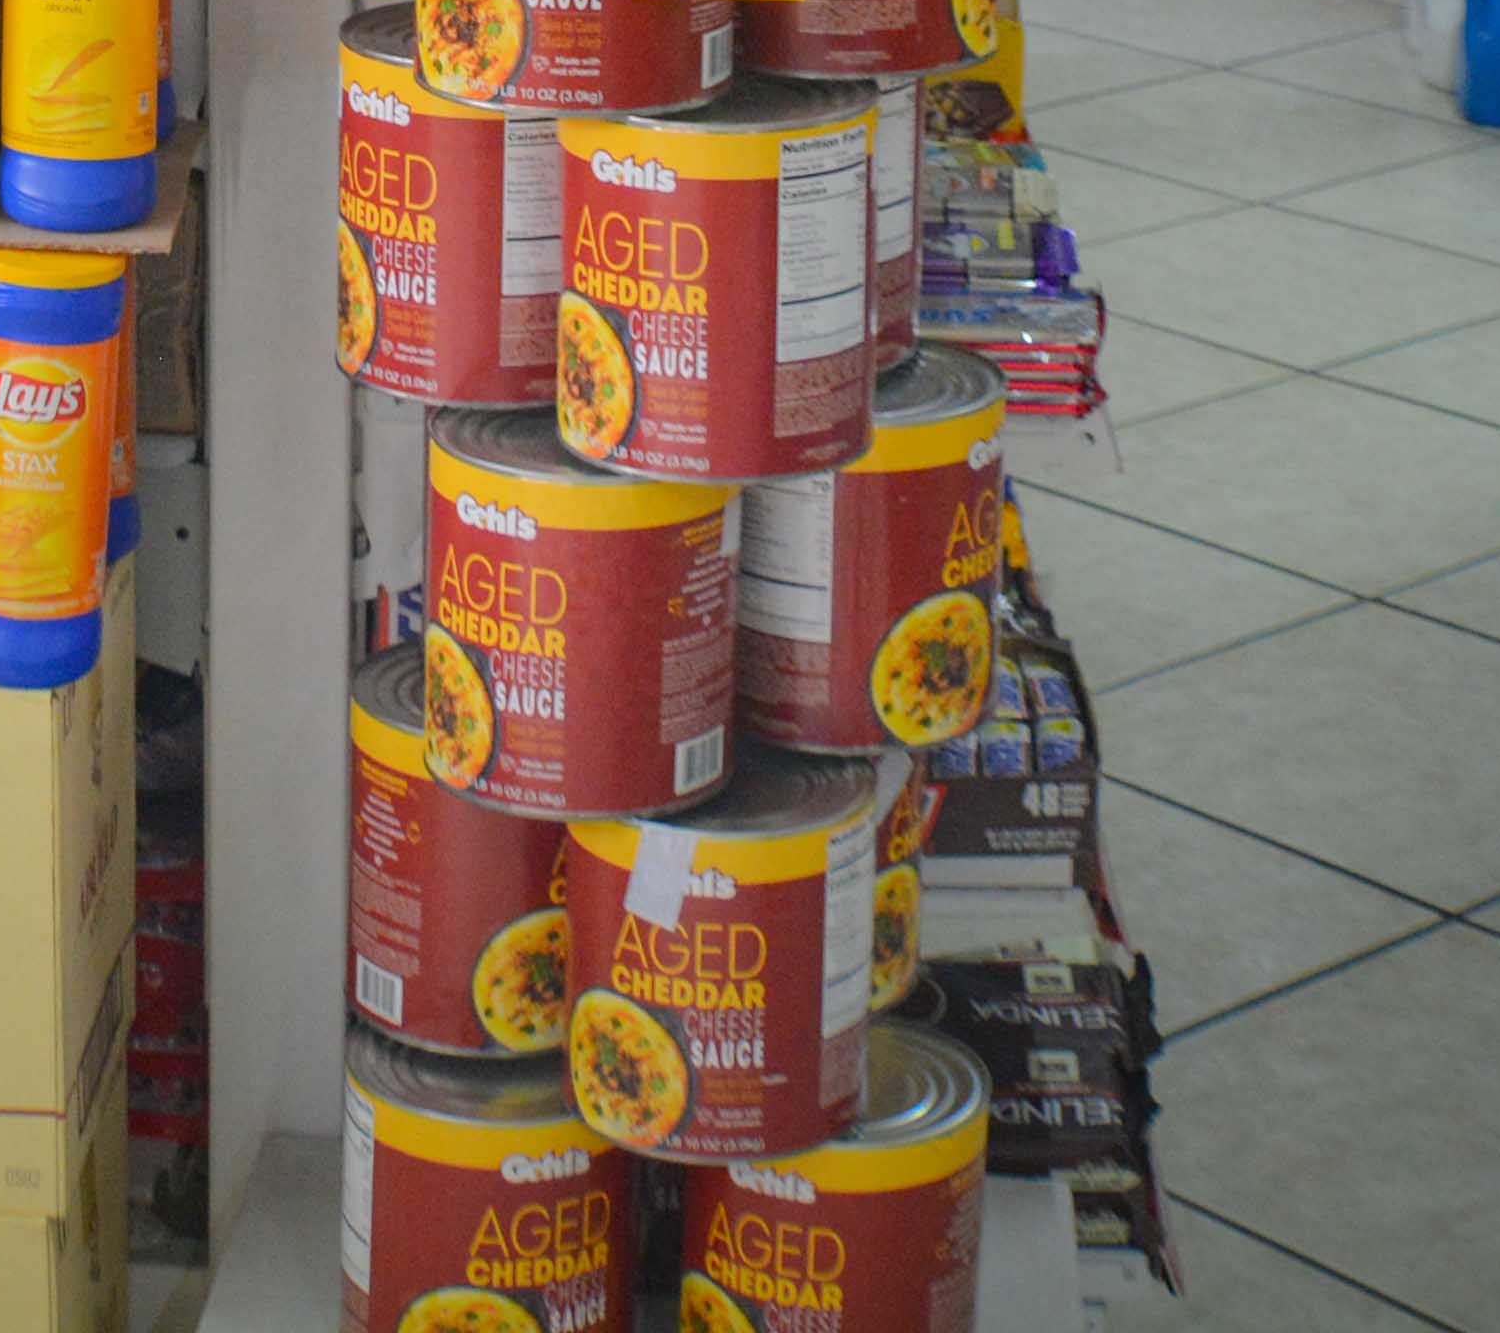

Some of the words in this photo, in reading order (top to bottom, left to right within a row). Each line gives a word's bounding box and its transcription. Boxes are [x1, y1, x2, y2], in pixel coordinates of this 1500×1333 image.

[348, 81, 411, 126] Gehl's
[520, 87, 535, 99] 10
[539, 88, 557, 100] OZ
[339, 133, 438, 212] AGED
[591, 148, 677, 193] Gehl's
[339, 188, 437, 243] CHEDDAR
[372, 234, 437, 274] CHEESE
[573, 204, 711, 283] AGED
[375, 267, 437, 306] SAUCE
[573, 261, 709, 315] CHEDDAR
[628, 309, 709, 350] CHEESE
[634, 342, 709, 381] SAUCE
[2, 451, 59, 476] STAX
[456, 491, 539, 542] Gehl's
[439, 543, 569, 627] AGED
[438, 594, 566, 657] CHEDDAR
[491, 650, 566, 690] CHEESE
[495, 682, 566, 721] SAUCE
[612, 913, 768, 982] AGED
[611, 966, 766, 1011] CHEDDAR
[683, 1007, 765, 1040] CHEESE
[690, 1037, 765, 1072] SAUCE
[500, 1147, 592, 1184] Gehl's
[468, 1191, 612, 1261] AGED
[707, 1204, 846, 1285] AGED
[465, 1241, 609, 1289] CHEDDAR
[704, 1250, 845, 1312] CHEDDAR
